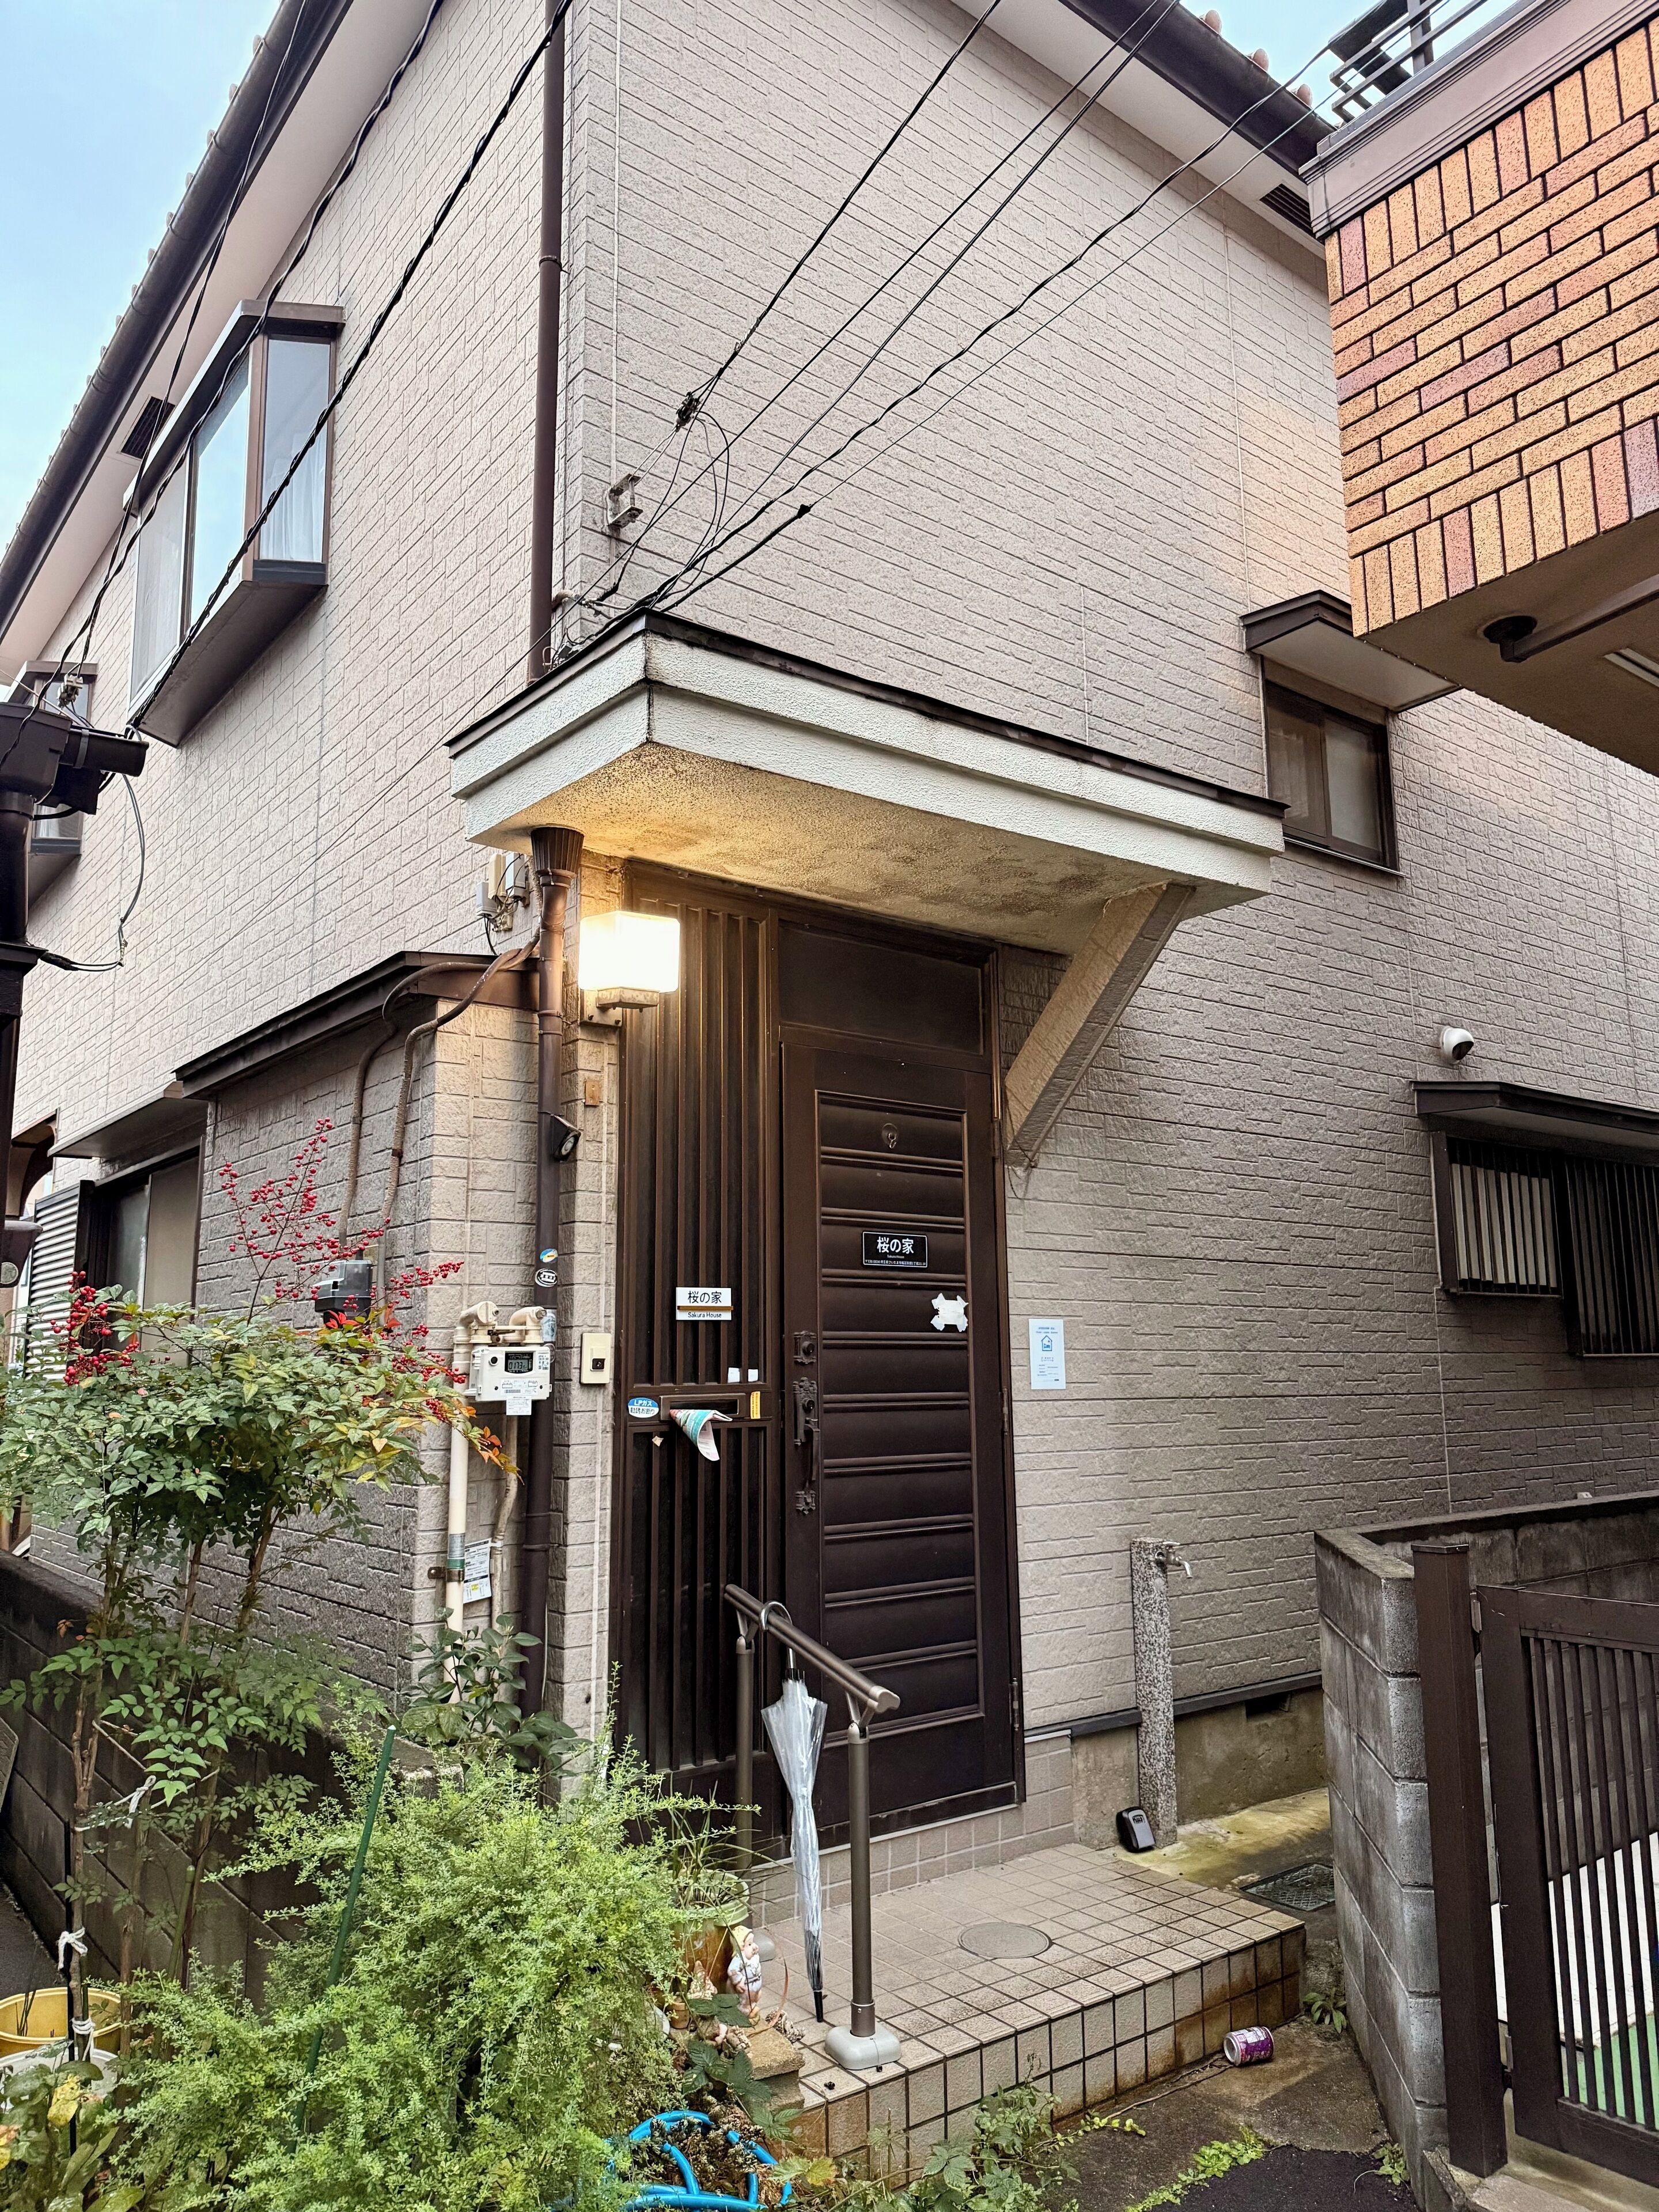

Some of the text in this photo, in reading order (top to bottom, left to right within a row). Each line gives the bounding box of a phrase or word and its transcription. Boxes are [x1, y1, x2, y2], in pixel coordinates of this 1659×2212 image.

[877, 1236, 914, 1254] 桜の家
[688, 1290, 722, 1304] 桜の家
